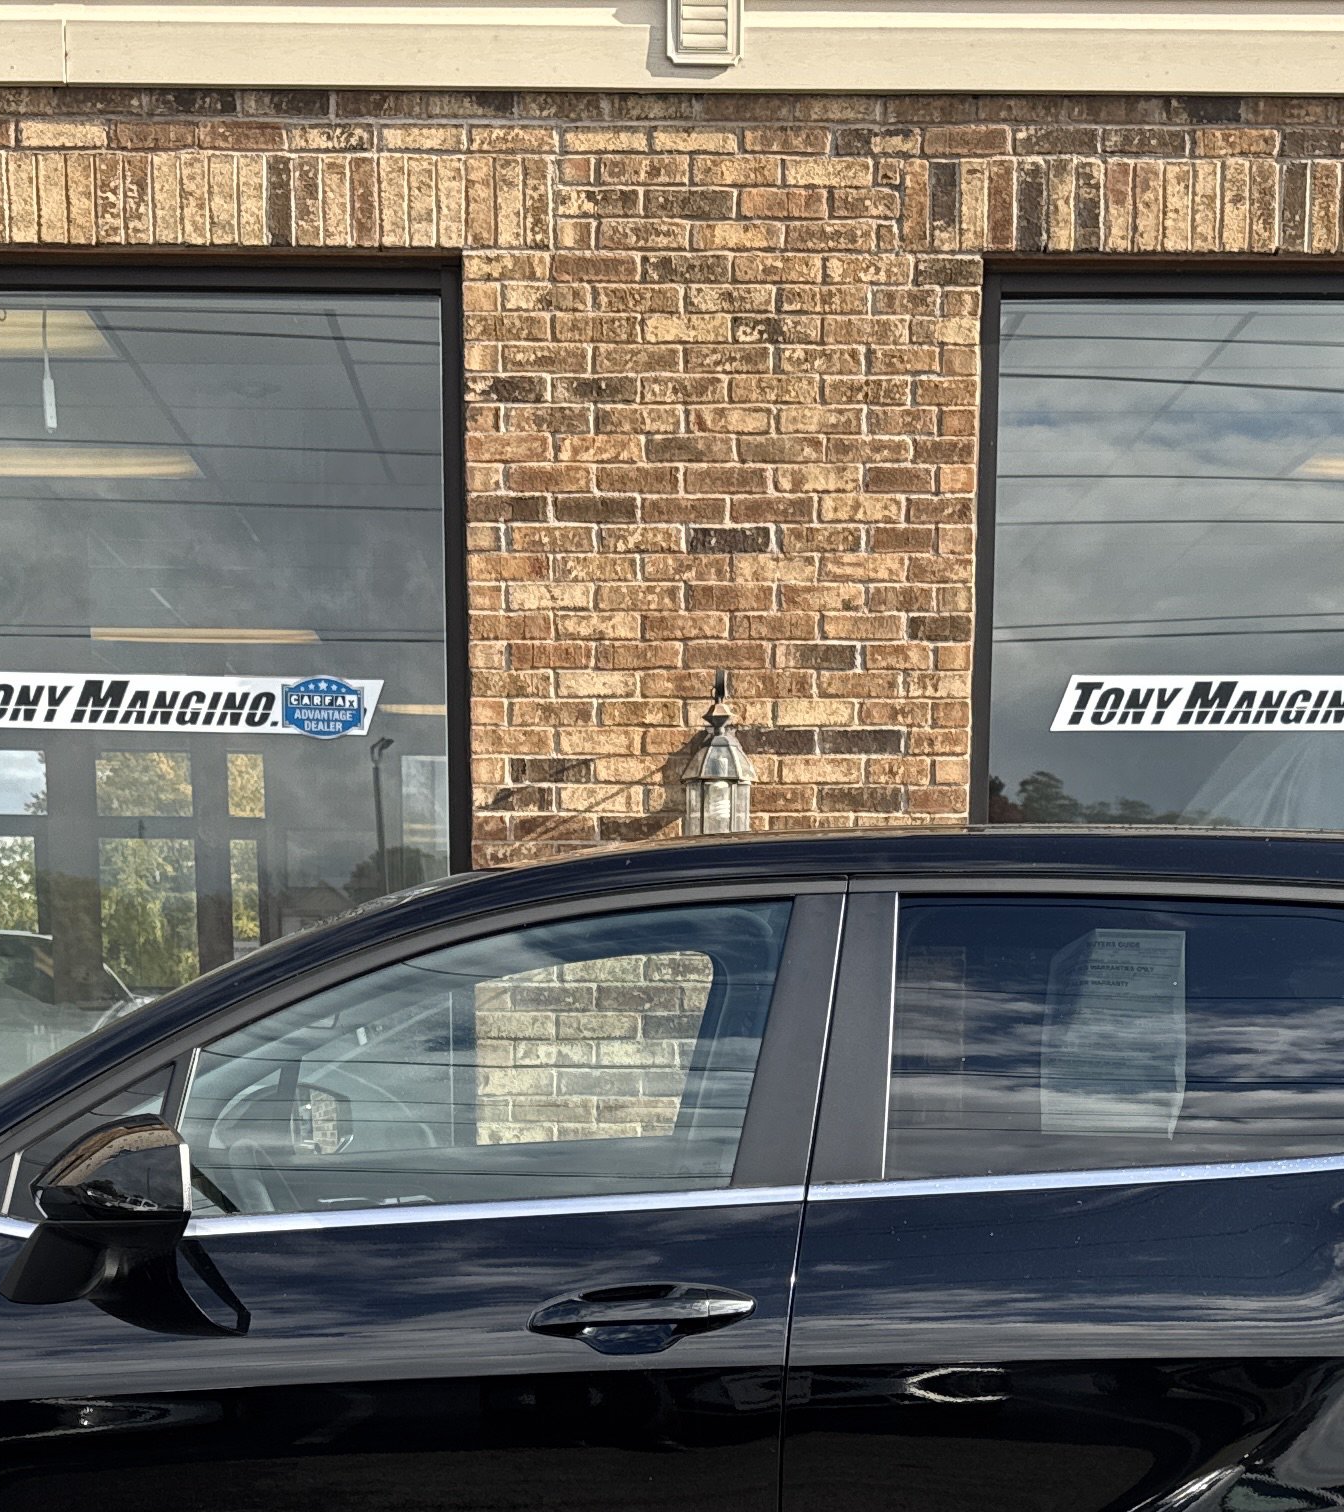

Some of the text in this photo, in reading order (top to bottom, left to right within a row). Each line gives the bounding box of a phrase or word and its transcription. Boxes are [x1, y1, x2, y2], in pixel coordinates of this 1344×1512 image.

[288, 694, 359, 709] CARFAX
[1067, 681, 1184, 726] TONY
[293, 709, 354, 722] ADVANTAGE
[304, 720, 343, 732] DEALER
